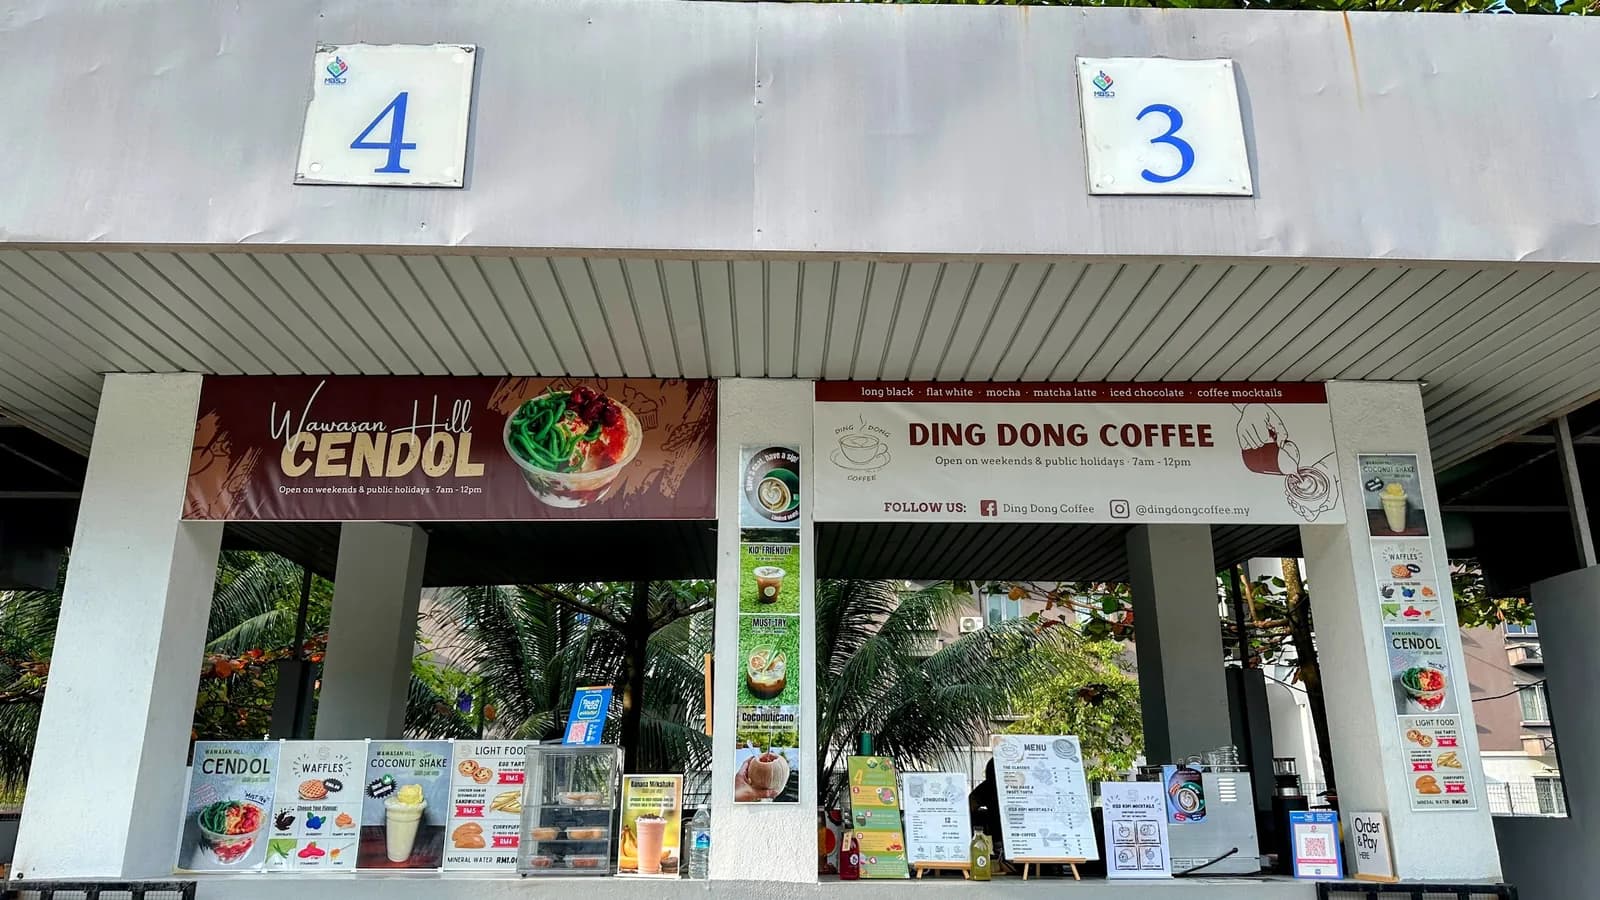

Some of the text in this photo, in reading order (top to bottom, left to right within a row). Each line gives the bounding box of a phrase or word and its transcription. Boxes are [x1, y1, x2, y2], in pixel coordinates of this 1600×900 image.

[349, 92, 417, 173] 4
[1136, 103, 1195, 183] 3
[861, 387, 914, 399] long black
[926, 387, 974, 397] flat white
[986, 388, 1021, 397] mocha
[1033, 388, 1097, 398] matcha latte
[1110, 387, 1185, 398] iced chocolate
[1197, 387, 1283, 398] coffee mocktails
[270, 379, 473, 454] Wawasan Hill
[834, 424, 892, 438] DING DONG
[908, 422, 1215, 448] DING DONG COFFEE
[280, 432, 486, 478] CENDOL
[765, 452, 781, 461] have
[934, 456, 963, 467] Open
[980, 456, 1033, 466] weekends
[1034, 457, 1043, 466] &
[1044, 456, 1079, 468] public
[1080, 456, 1125, 468] holidays
[1131, 457, 1155, 467] 7am
[1163, 457, 1191, 469] 12pm
[1363, 465, 1416, 473] COCONUT SHAKE
[847, 474, 877, 482] COFFEE
[279, 485, 301, 496] Open
[302, 486, 314, 494] on
[315, 484, 357, 494] weekends
[358, 485, 365, 494] &
[366, 484, 393, 496] public
[394, 484, 430, 496] holidays
[435, 485, 454, 494] 7am
[460, 485, 482, 496] 12pm
[883, 501, 967, 513] FOLLOW US:
[1003, 503, 1095, 516] Ding Dong Coffee
[1135, 503, 1251, 516] @dingdongcoffee.my
[761, 546, 793, 555] FRIENDLY
[1389, 553, 1418, 561] WAFFLES
[1392, 637, 1442, 650] CENDOL
[742, 712, 794, 722] Coconuticano
[1415, 719, 1455, 727] LIGHT FOOD
[475, 746, 501, 756] LIGHT
[1024, 743, 1047, 752] MENU
[202, 757, 271, 774] CENDOL
[302, 763, 344, 773] WAFFLES
[370, 758, 448, 768] COCONUT SHAKE
[1354, 816, 1380, 833] Order
[1357, 833, 1378, 853] & Pay
[447, 856, 472, 864] MINERAL
[473, 856, 493, 864] WATER
